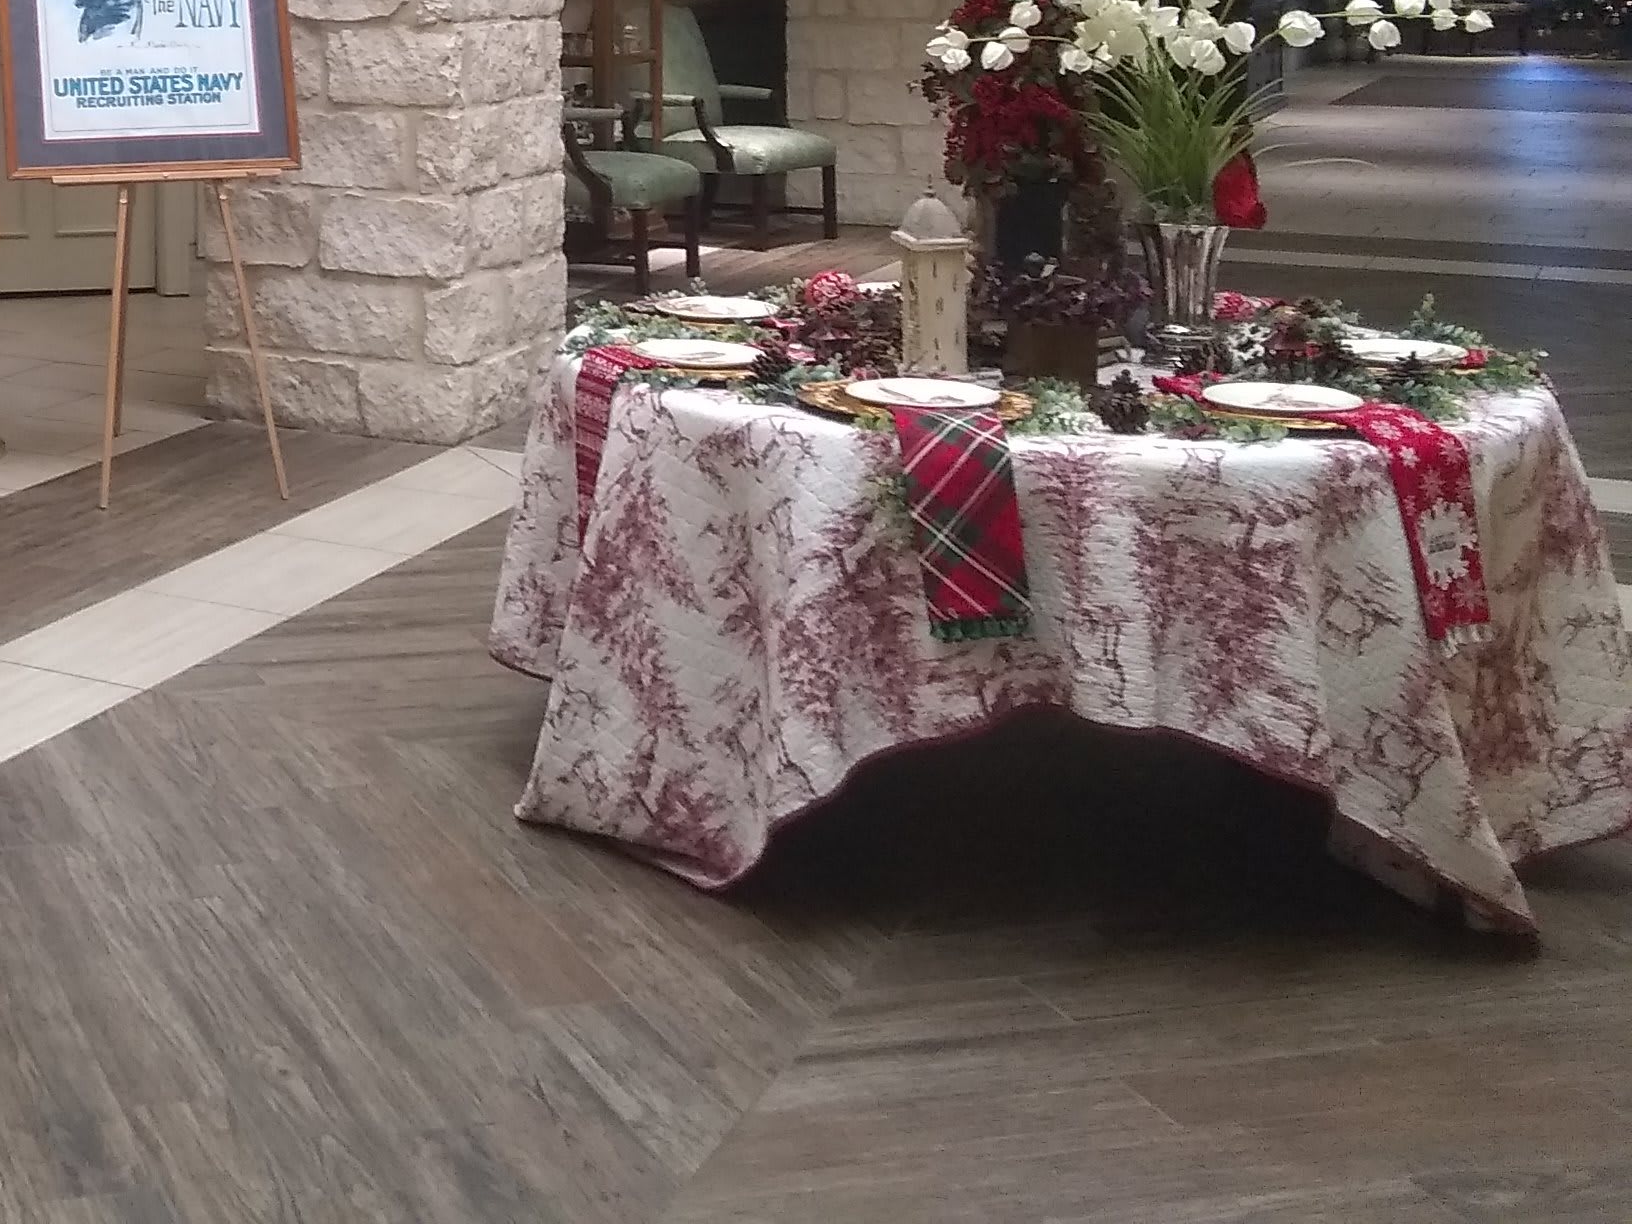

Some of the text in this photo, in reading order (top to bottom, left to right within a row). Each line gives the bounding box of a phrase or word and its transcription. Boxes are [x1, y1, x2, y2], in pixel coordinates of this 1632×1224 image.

[53, 72, 243, 97] UNITED STATES NAVY
[76, 92, 222, 108] RECRUITING STATION
